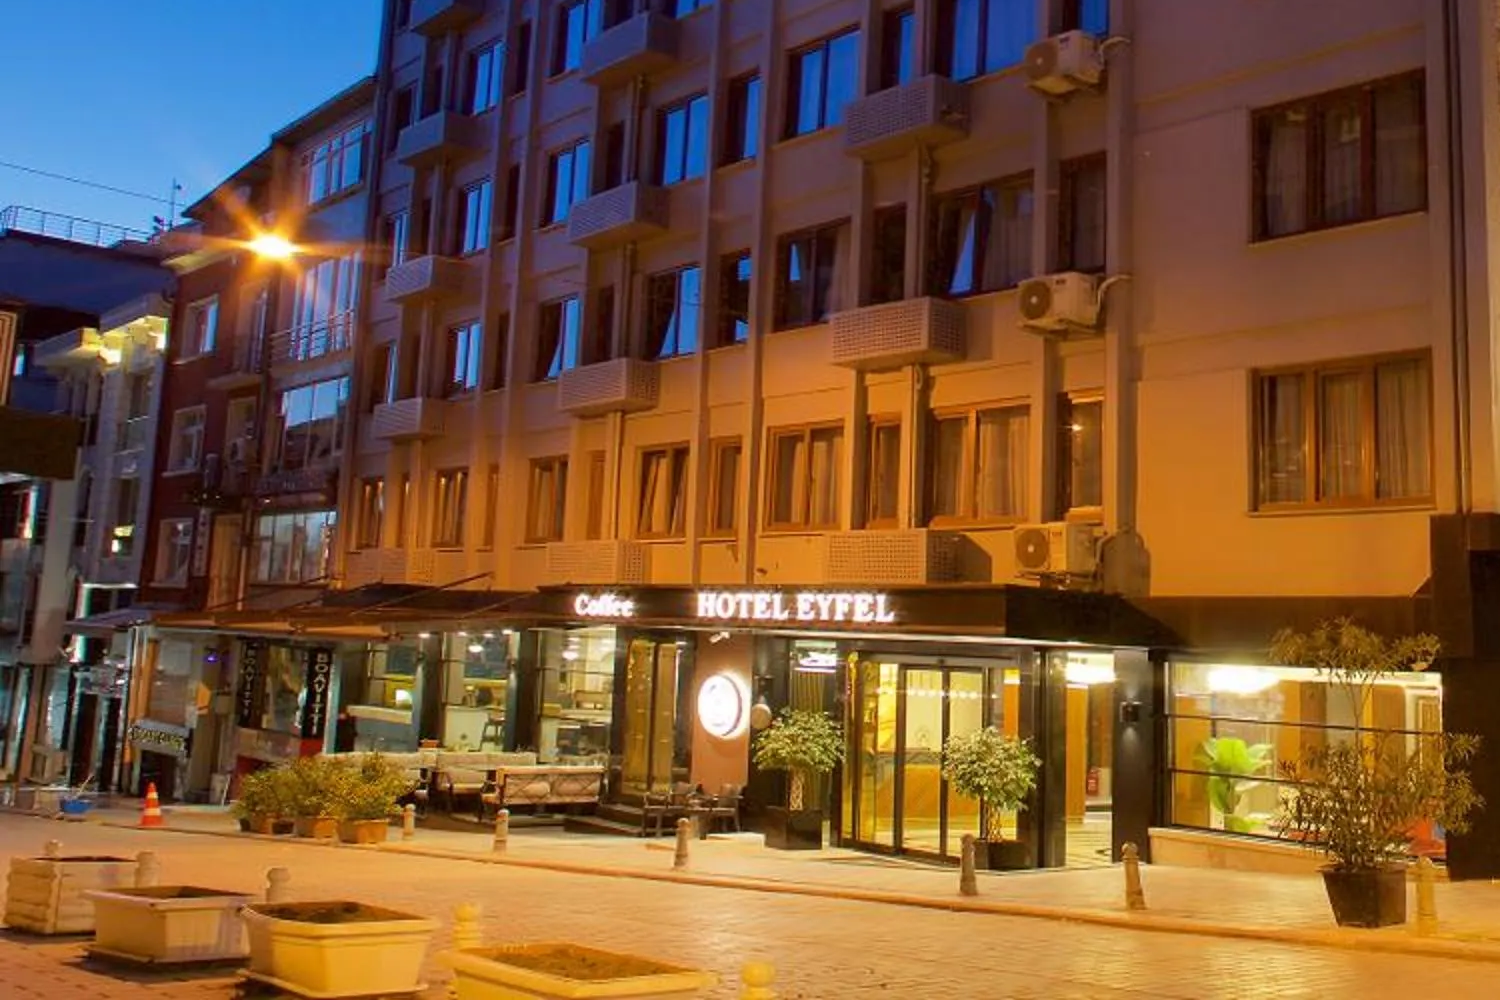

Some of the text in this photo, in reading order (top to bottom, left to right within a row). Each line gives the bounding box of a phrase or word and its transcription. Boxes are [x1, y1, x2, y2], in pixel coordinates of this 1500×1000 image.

[575, 594, 634, 616] Coffee
[697, 593, 895, 623] HOTEL EYFEL
[312, 652, 329, 735] BOAVITTI
